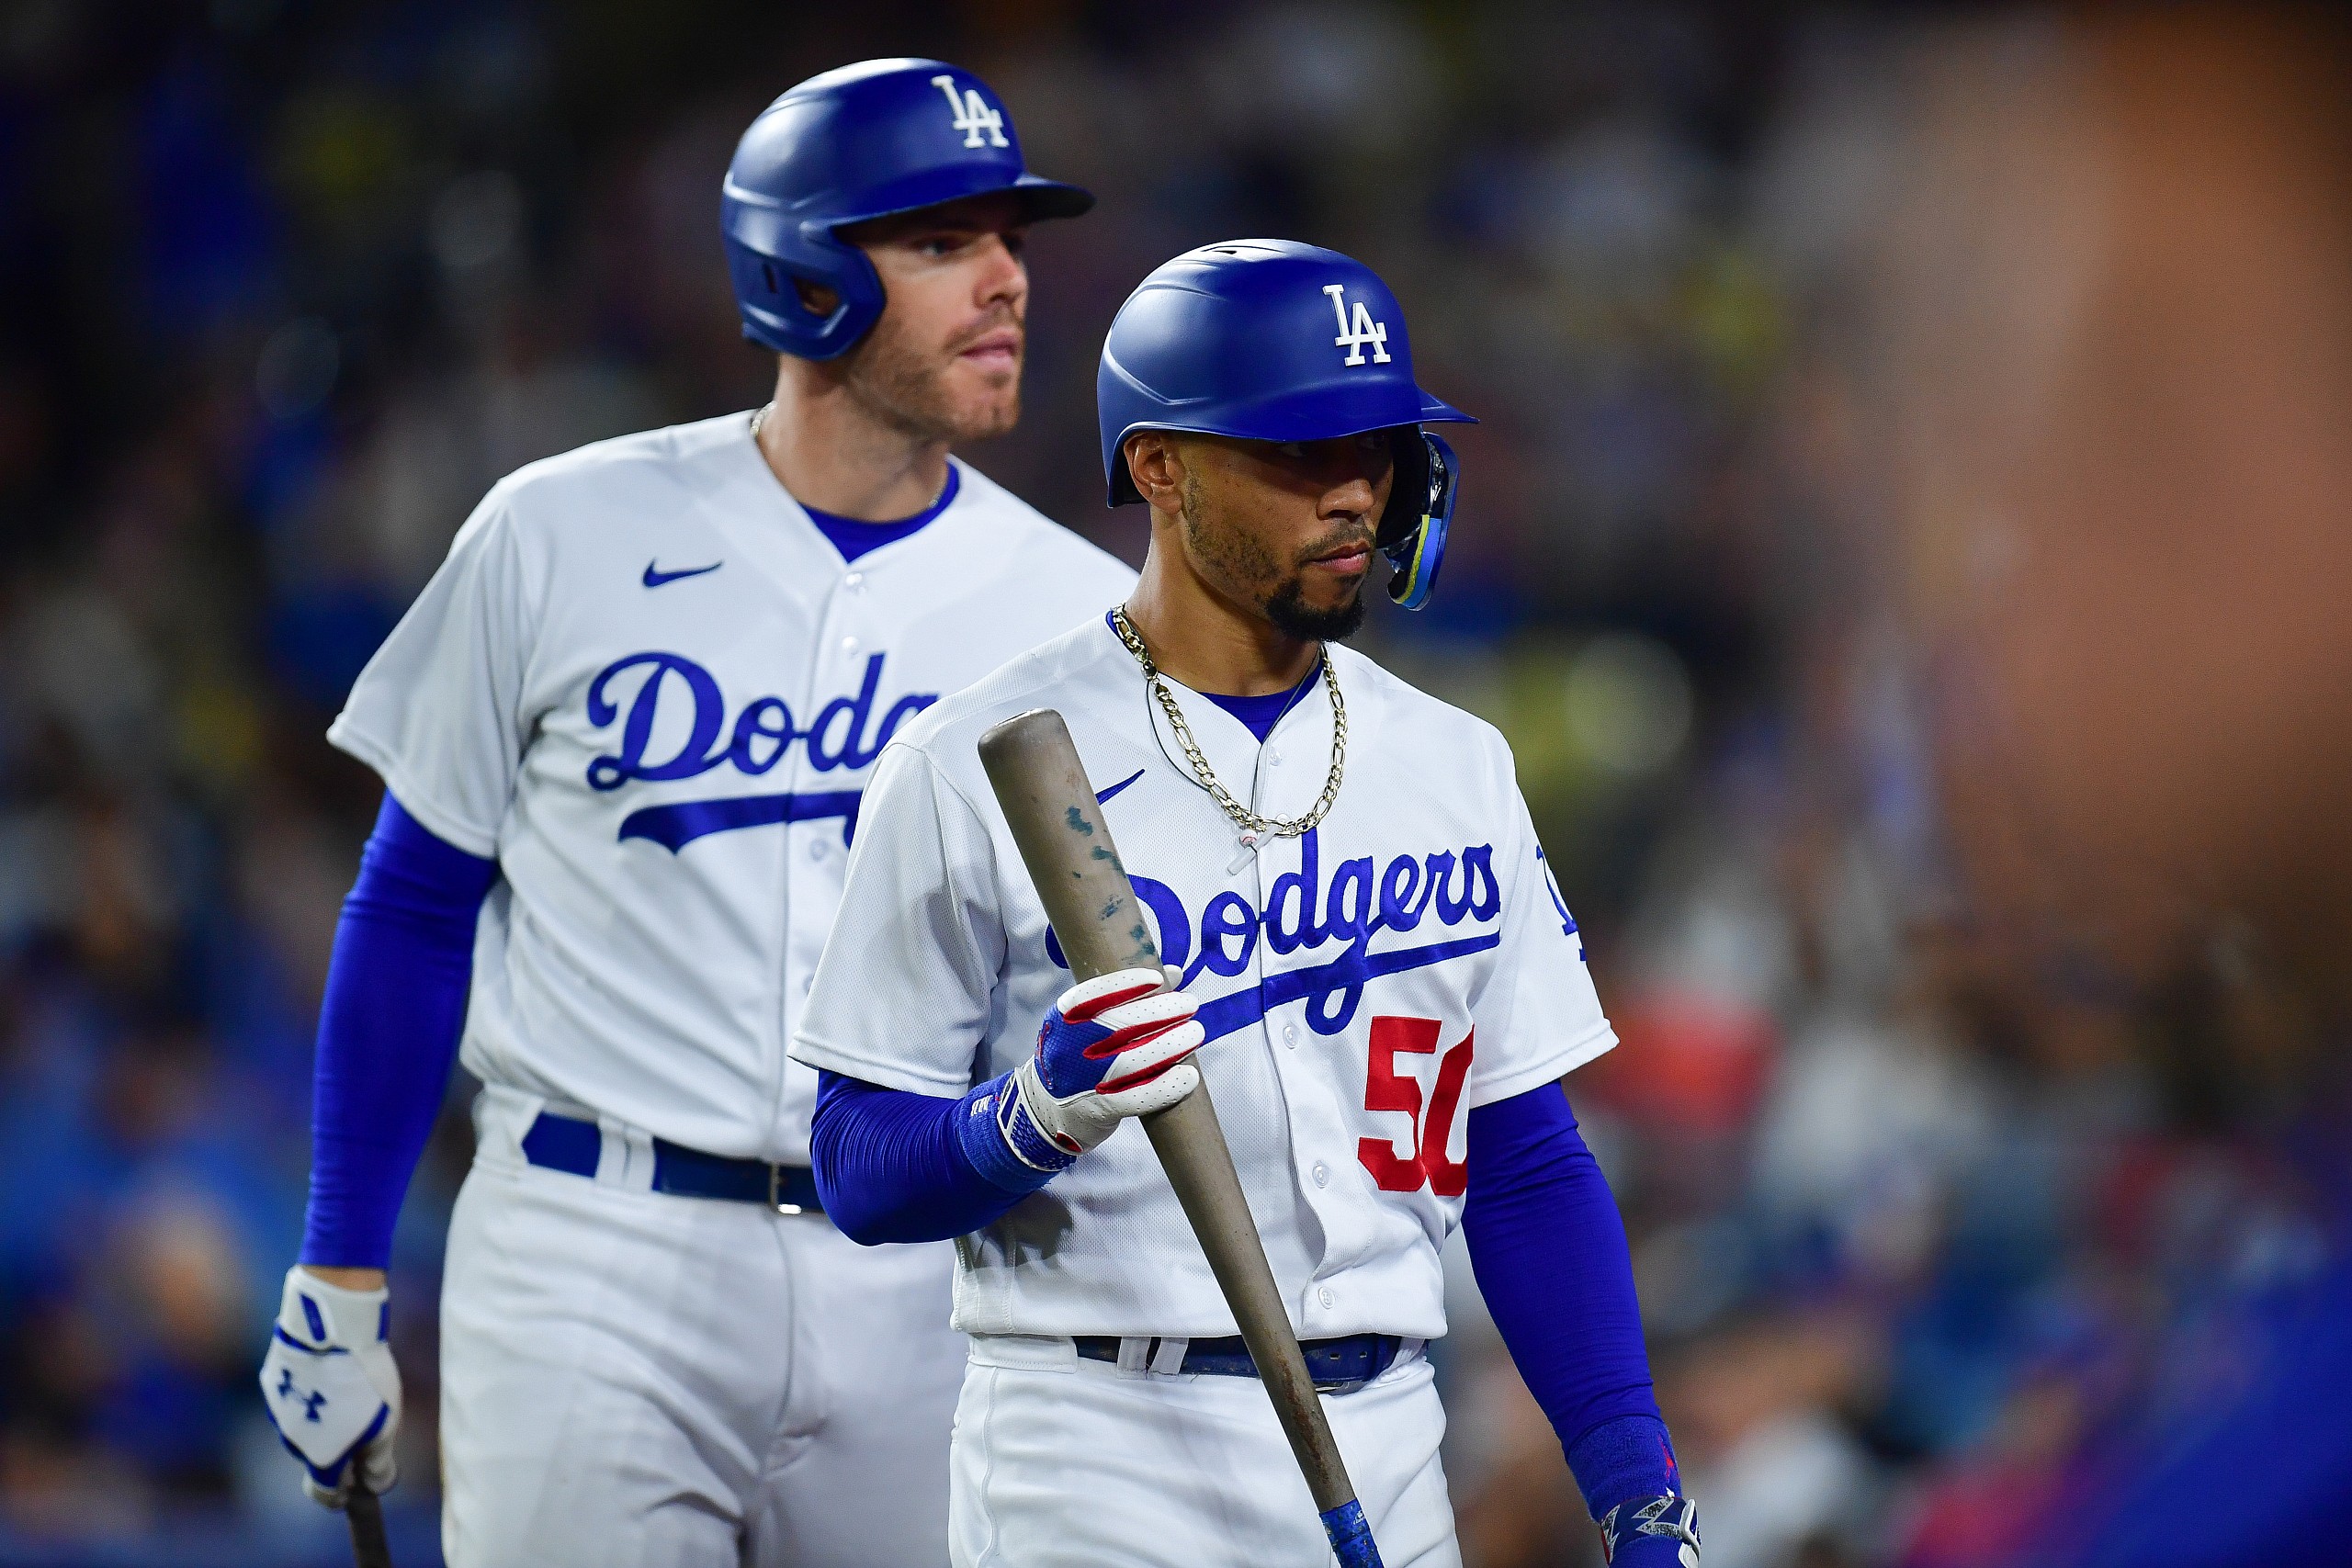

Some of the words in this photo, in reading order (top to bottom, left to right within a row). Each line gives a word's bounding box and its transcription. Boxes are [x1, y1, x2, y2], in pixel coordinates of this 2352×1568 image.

[931, 74, 1010, 149] LA
[1322, 284, 1391, 367] LA
[1357, 1015, 1475, 1198] 50
